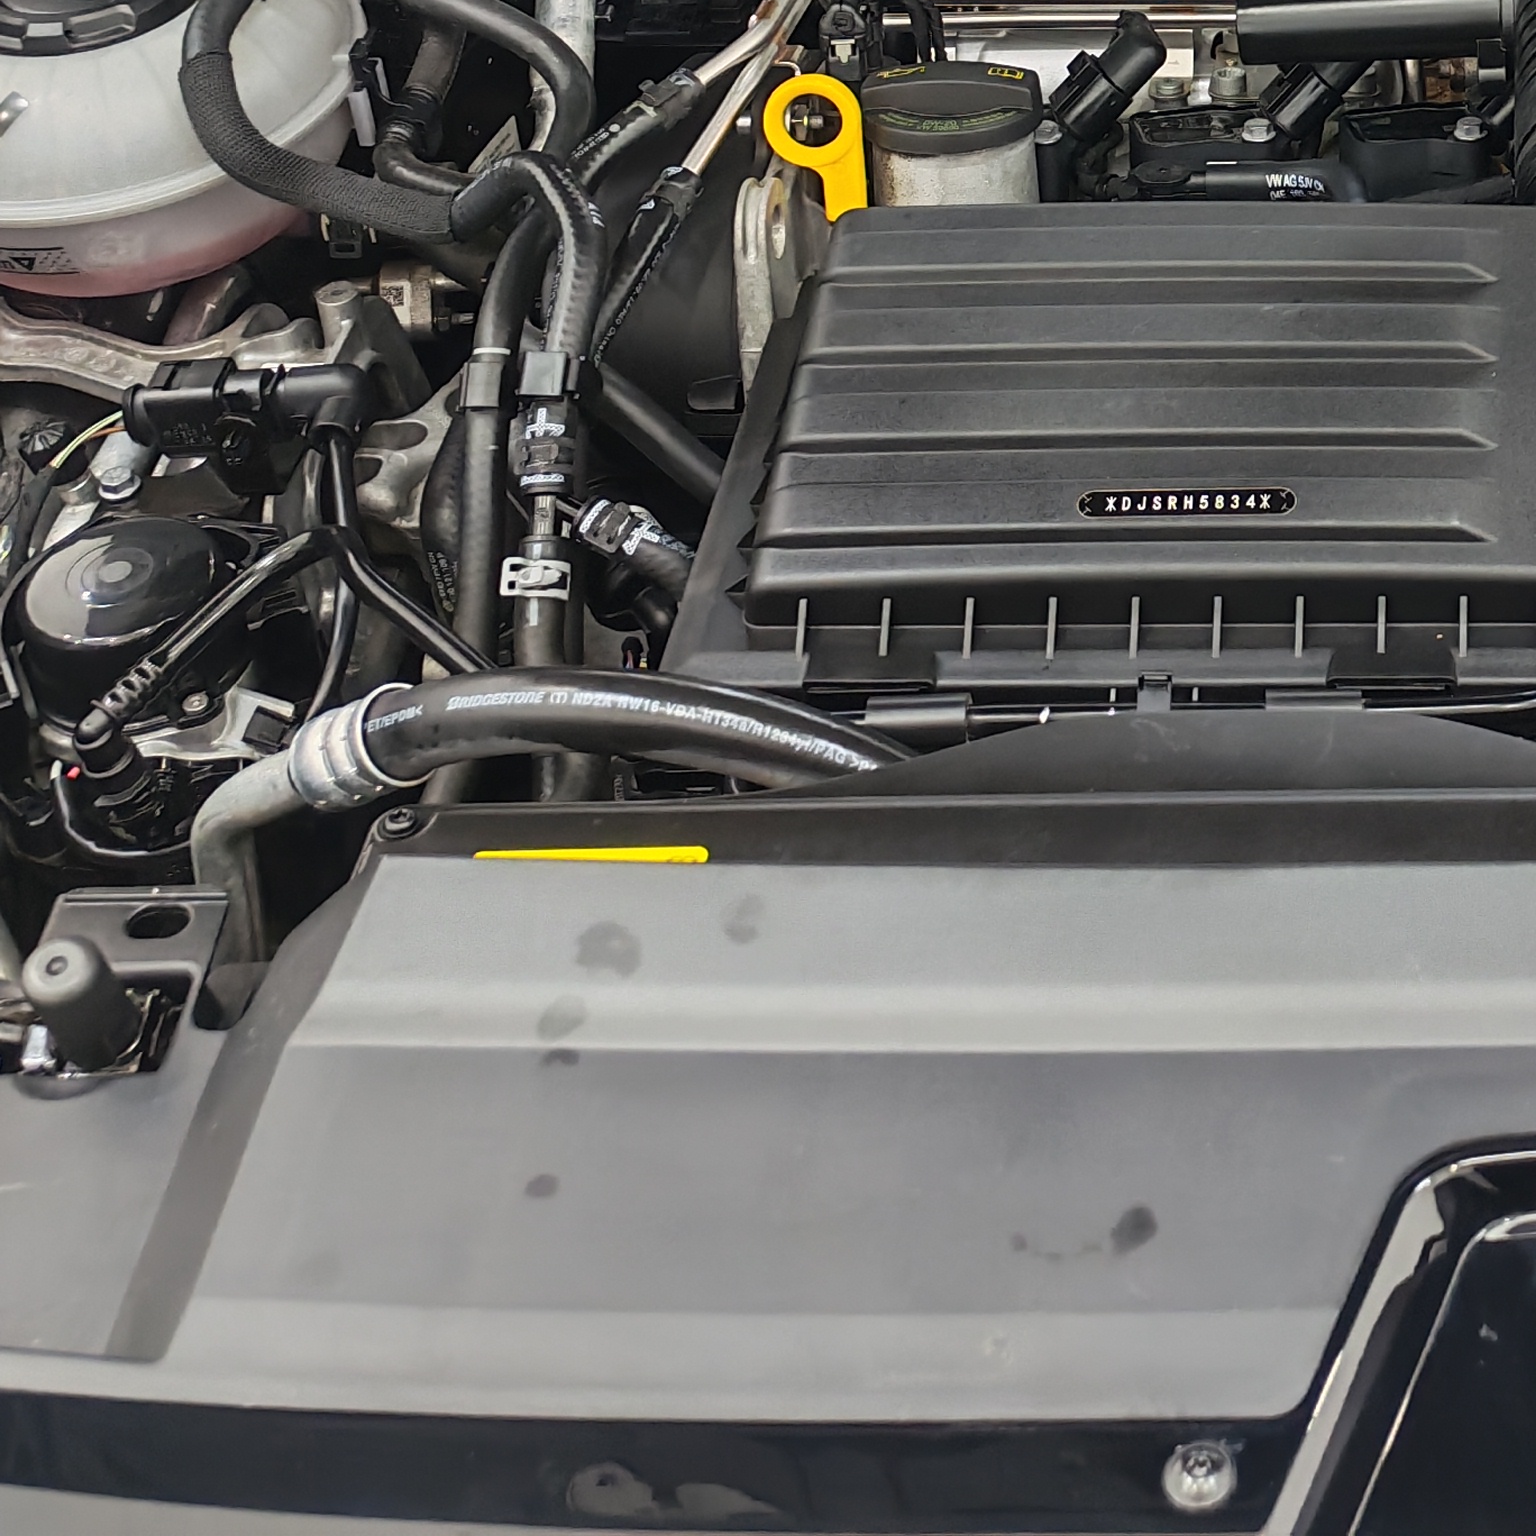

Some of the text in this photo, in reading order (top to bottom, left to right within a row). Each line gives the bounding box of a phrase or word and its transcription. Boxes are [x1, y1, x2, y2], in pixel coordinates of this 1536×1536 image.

[1265, 173, 1283, 188] VW
[1283, 173, 1298, 188] AG
[364, 704, 424, 733] ET/EPDM<
[445, 691, 546, 711] BRIDGESTONE
